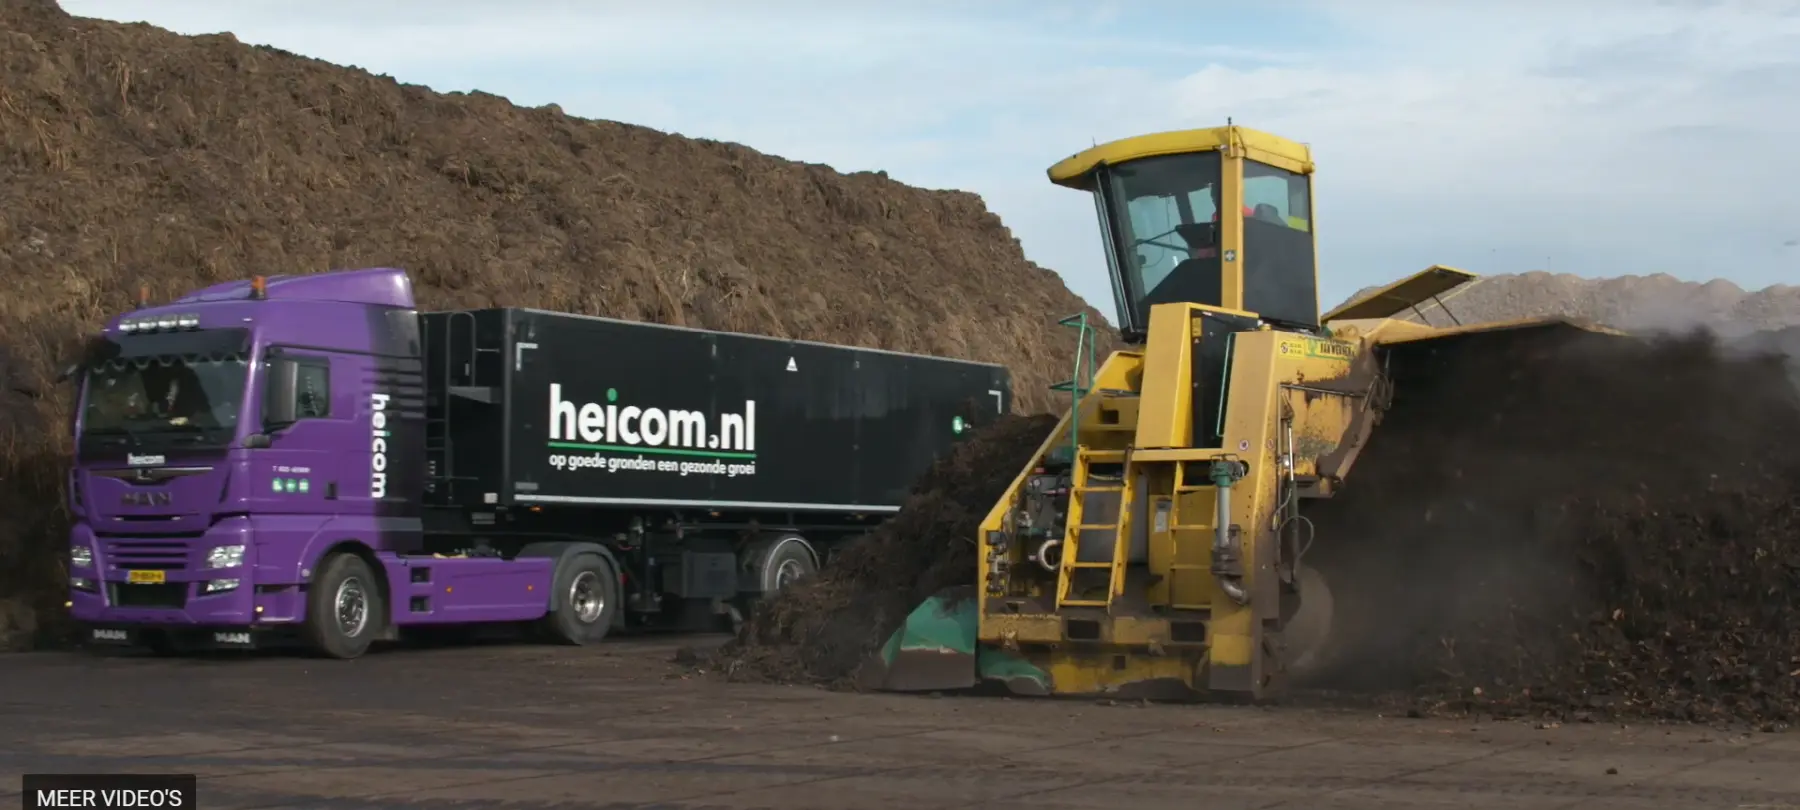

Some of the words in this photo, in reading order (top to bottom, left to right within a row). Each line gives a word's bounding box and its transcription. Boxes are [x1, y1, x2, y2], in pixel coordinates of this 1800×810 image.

[549, 382, 755, 450] heicom.nl
[371, 393, 391, 498] heicom
[549, 454, 566, 470] op
[568, 452, 606, 471] goede
[608, 454, 656, 473] gronden
[657, 460, 679, 472] een
[680, 459, 727, 476] gezonde
[728, 461, 755, 477] groei
[215, 632, 250, 644] MAN
